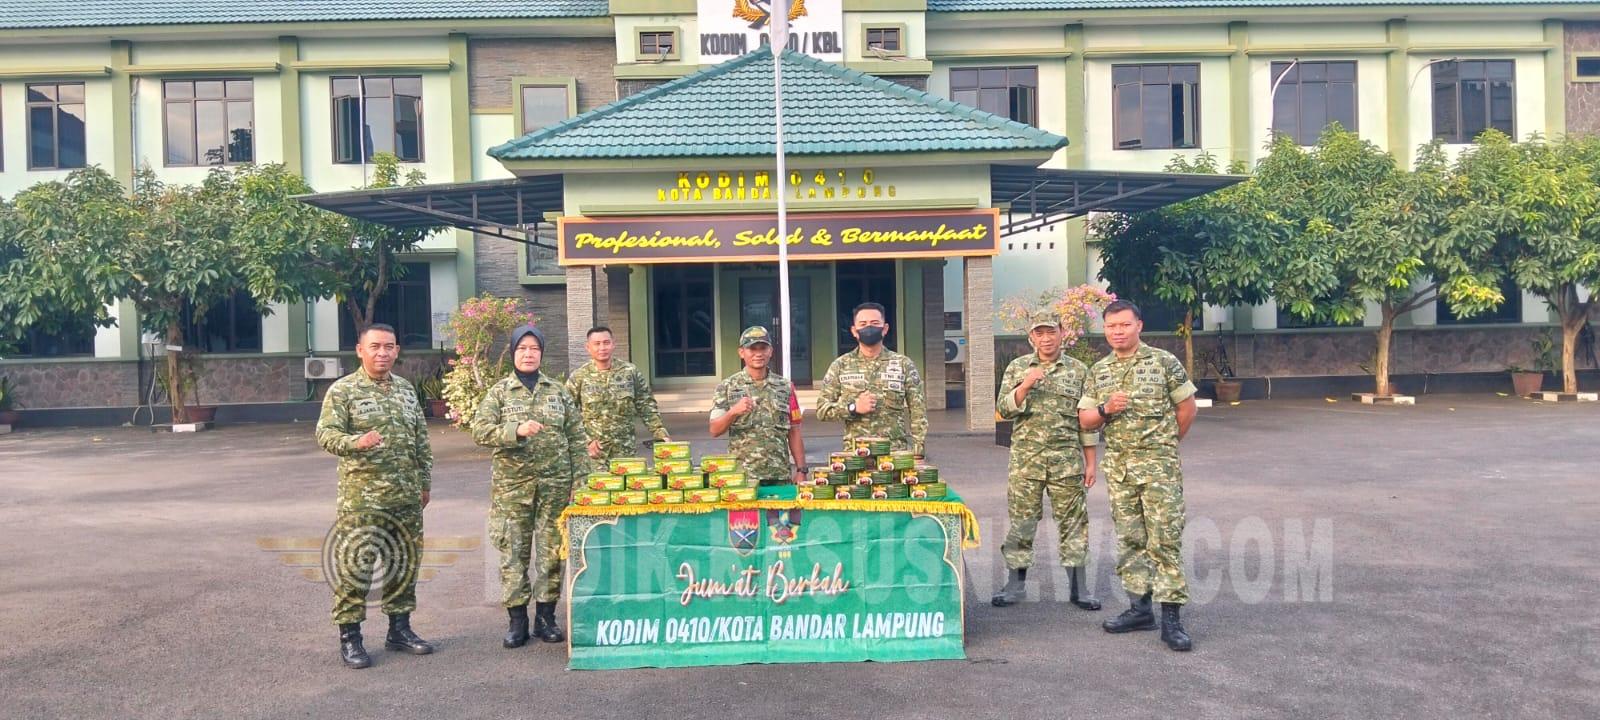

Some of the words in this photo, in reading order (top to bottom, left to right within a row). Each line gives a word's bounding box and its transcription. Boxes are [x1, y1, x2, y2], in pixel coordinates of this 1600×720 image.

[700, 33, 747, 55] KODIM
[812, 31, 841, 53] KBL
[678, 171, 769, 189] KODIM
[790, 168, 874, 186] 0410
[658, 188, 702, 201] KOTA
[796, 185, 896, 199] LAMPUNG
[574, 229, 721, 253] Profesional,
[810, 228, 832, 246] &
[841, 222, 988, 248] Bermanfaat
[675, 562, 761, 606] Jum'at
[765, 560, 850, 604] Berkah
[596, 618, 660, 646] KODIM
[664, 615, 764, 644] 0410/KOTA
[769, 613, 846, 641] BANDAR
[852, 611, 945, 639] LAMPUNG
